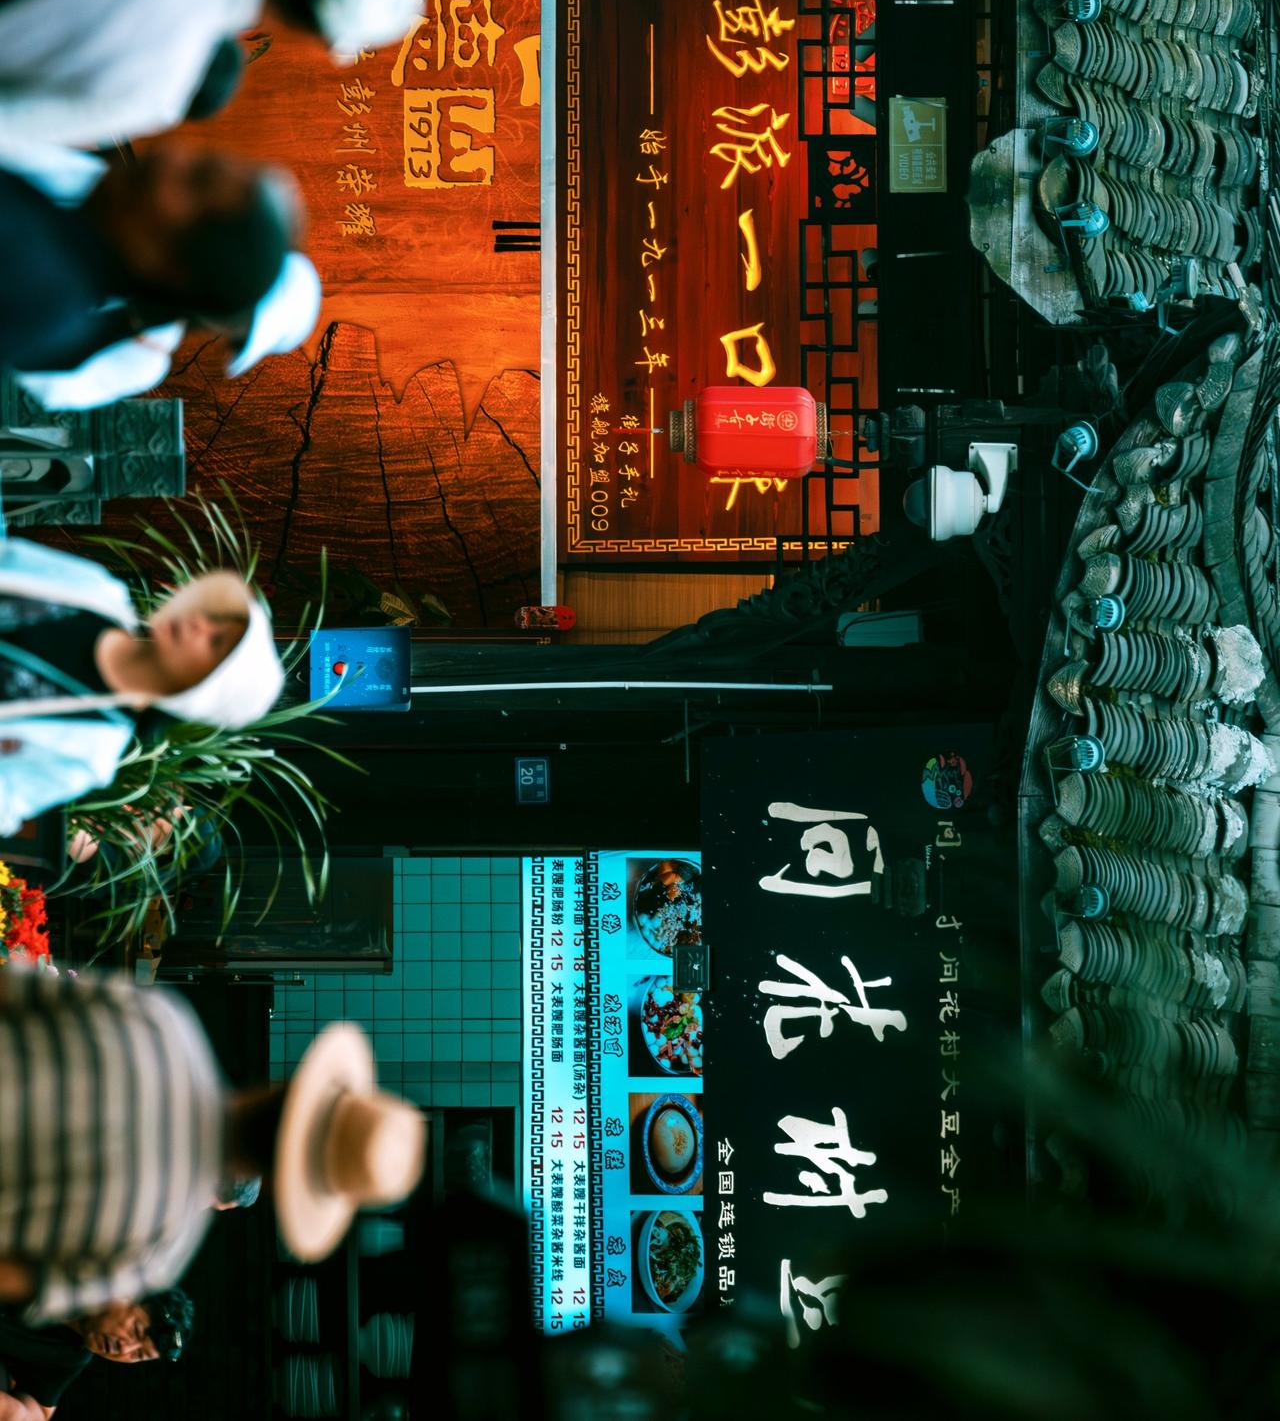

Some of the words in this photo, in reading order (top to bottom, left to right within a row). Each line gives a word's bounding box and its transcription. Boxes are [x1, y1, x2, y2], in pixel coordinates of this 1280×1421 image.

[408, 101, 432, 180] 1913
[899, 153, 910, 180] VIDEO
[635, 129, 670, 374] 始于一九一三年
[521, 767, 534, 785] 20
[602, 882, 621, 933] 冰粉
[551, 929, 563, 946] 12
[573, 930, 585, 947] 15
[551, 954, 563, 971] 15
[573, 954, 585, 972] 18
[551, 1106, 563, 1124] 12
[573, 1107, 586, 1125] 12
[551, 1131, 563, 1149] 15
[573, 1131, 586, 1150] 15
[550, 1287, 563, 1305] 12
[573, 1287, 586, 1305] 12
[550, 1312, 563, 1330] 15
[573, 1312, 586, 1329] 15
